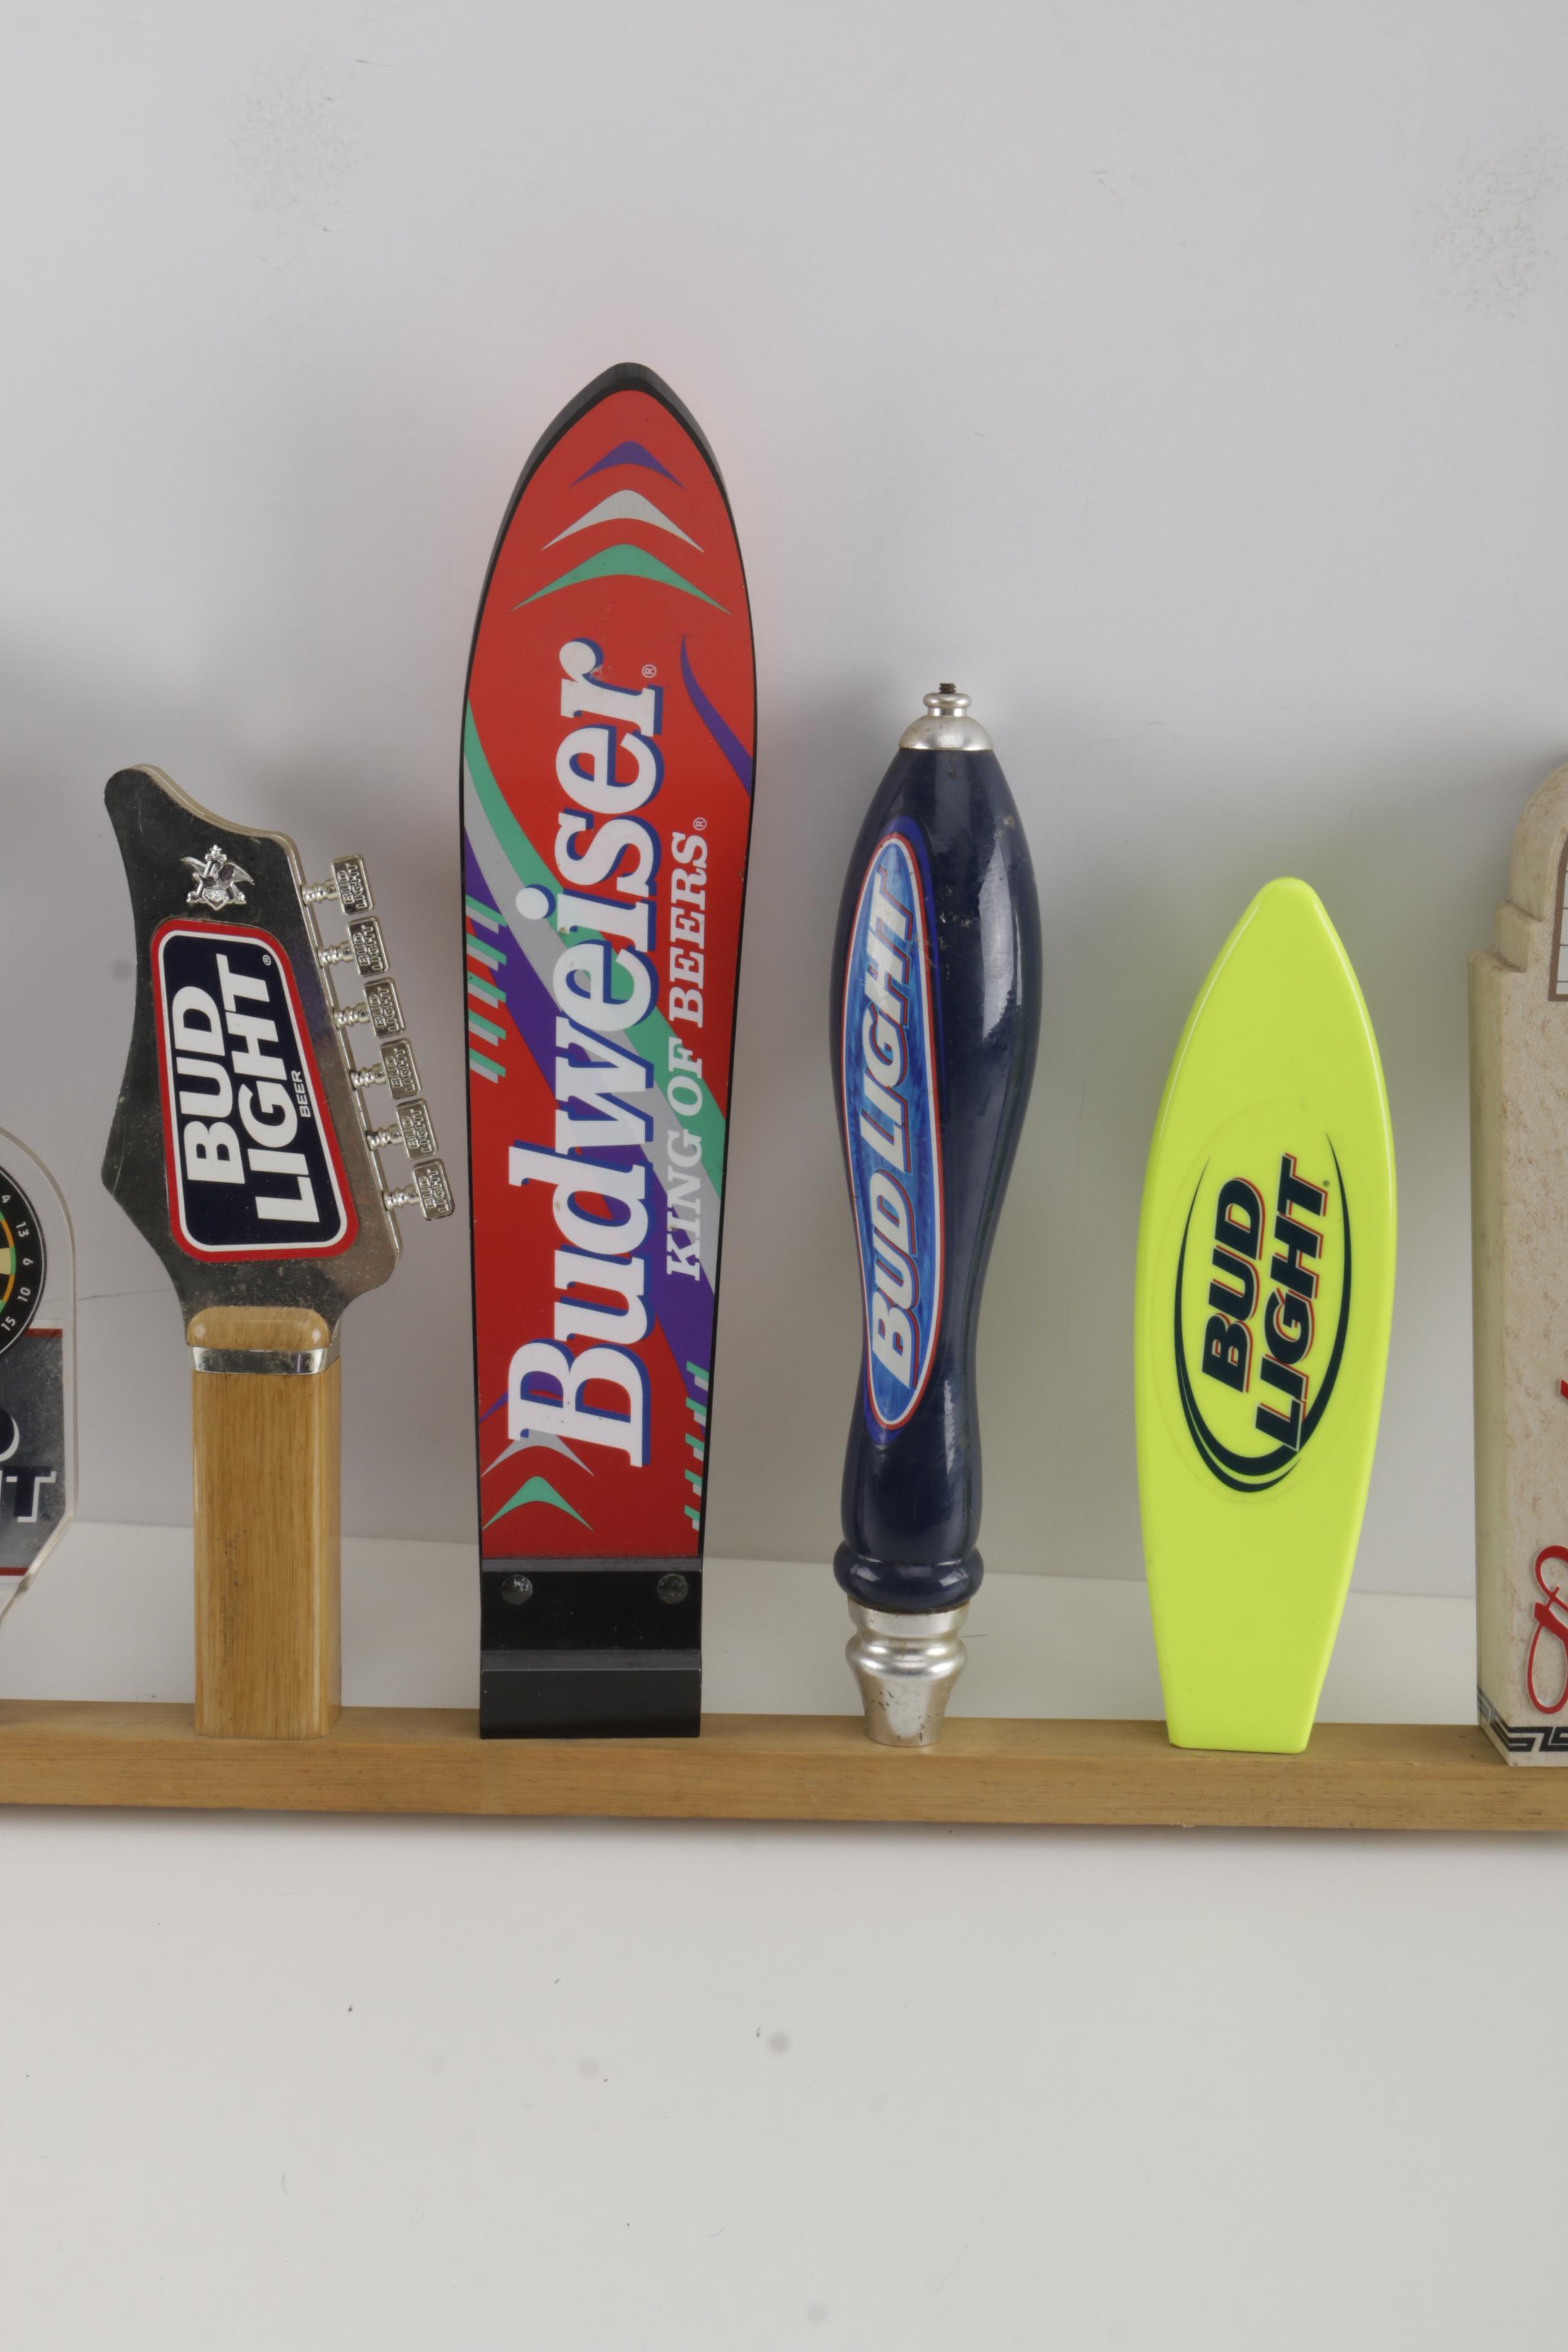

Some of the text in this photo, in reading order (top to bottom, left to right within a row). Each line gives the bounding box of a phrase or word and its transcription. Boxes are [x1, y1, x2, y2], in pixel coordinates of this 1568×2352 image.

[337, 870, 354, 905] BUD
[346, 863, 368, 909] LIGHT
[353, 932, 371, 966] BUD
[361, 925, 384, 972] LIGHT
[369, 994, 387, 1028] BUD
[377, 986, 400, 1034] LIGHT
[384, 1055, 402, 1088] BUD
[393, 1048, 416, 1093] LIGHT
[508, 637, 664, 1467] Budweiser
[667, 832, 708, 1281] KING OF BEERS
[172, 985, 246, 1184] BUD
[215, 953, 320, 1223] LIGHT
[297, 1070, 312, 1118] BEER
[402, 1116, 419, 1149] BUD
[410, 1108, 433, 1153] LIGHT
[859, 865, 921, 1389] BUD LIGHT
[1, 1195, 11, 1203] 4
[418, 1176, 436, 1209] BUD
[427, 1169, 449, 1213] LIGHT
[16, 1222, 29, 1237] 13
[17, 1287, 31, 1302] 10
[1202, 1177, 1266, 1393] BUD
[1255, 1152, 1328, 1451] LIGHT
[1, 1316, 16, 1331] 15
